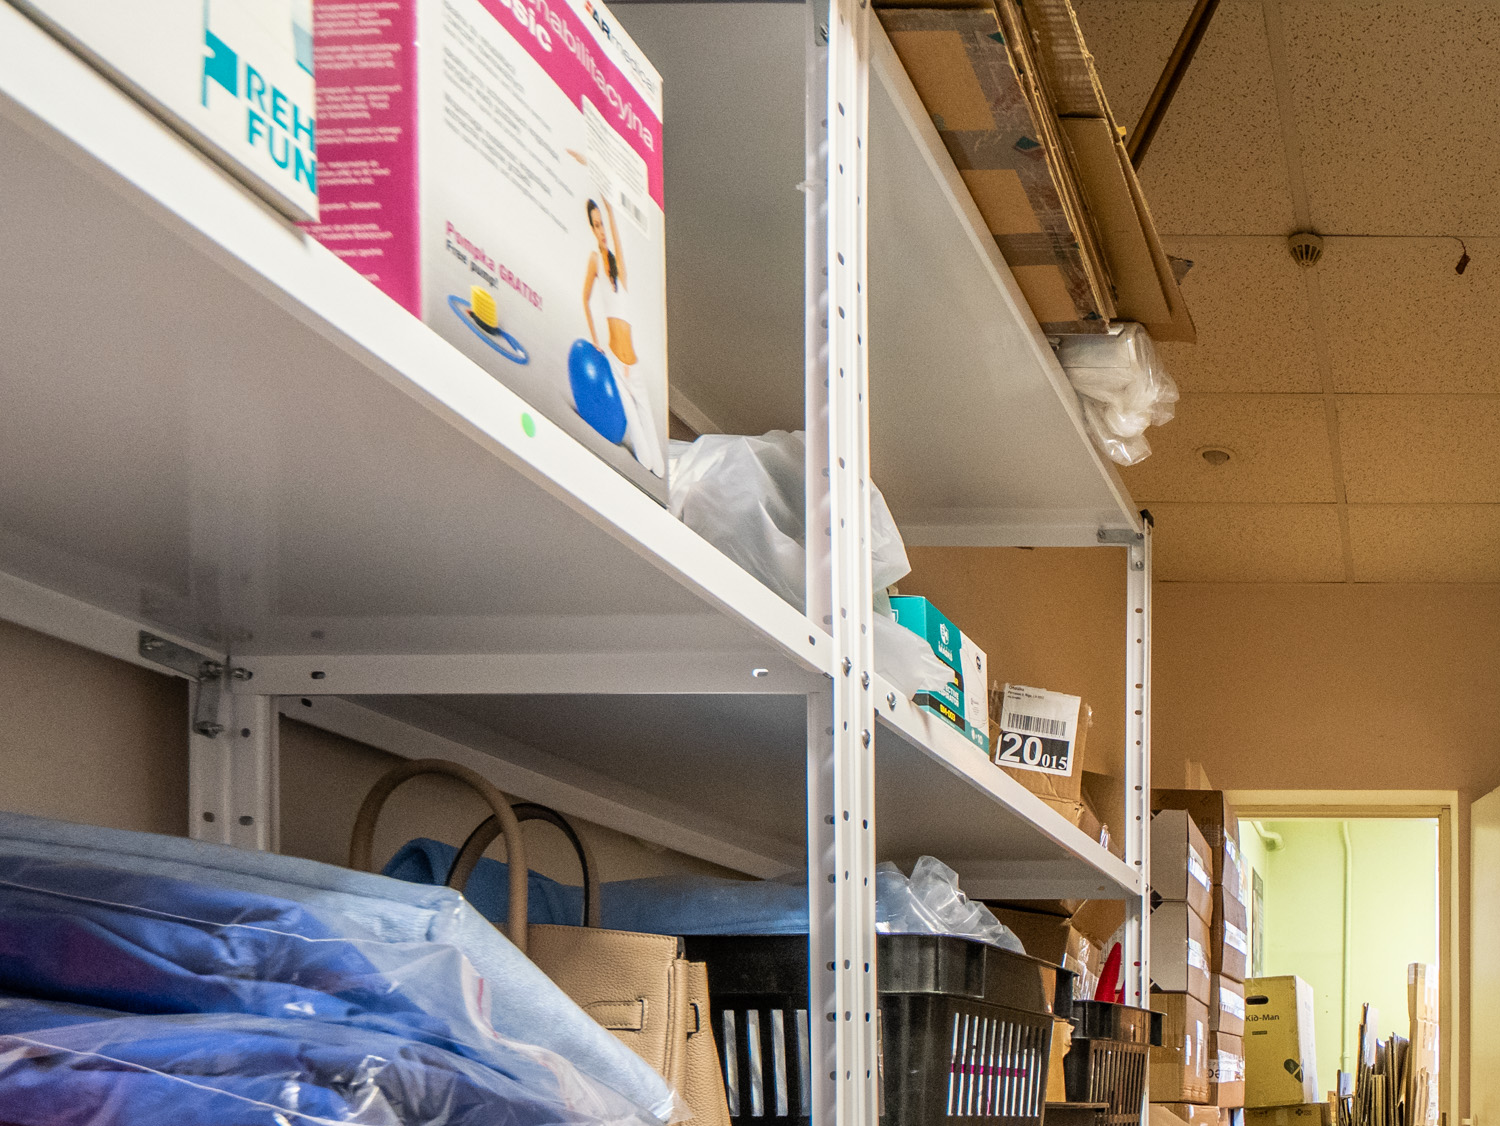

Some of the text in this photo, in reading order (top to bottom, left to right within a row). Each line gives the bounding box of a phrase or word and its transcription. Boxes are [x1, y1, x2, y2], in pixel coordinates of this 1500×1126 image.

[528, 0, 655, 152] habilitacyjna
[1000, 732, 1068, 770] 20 015
